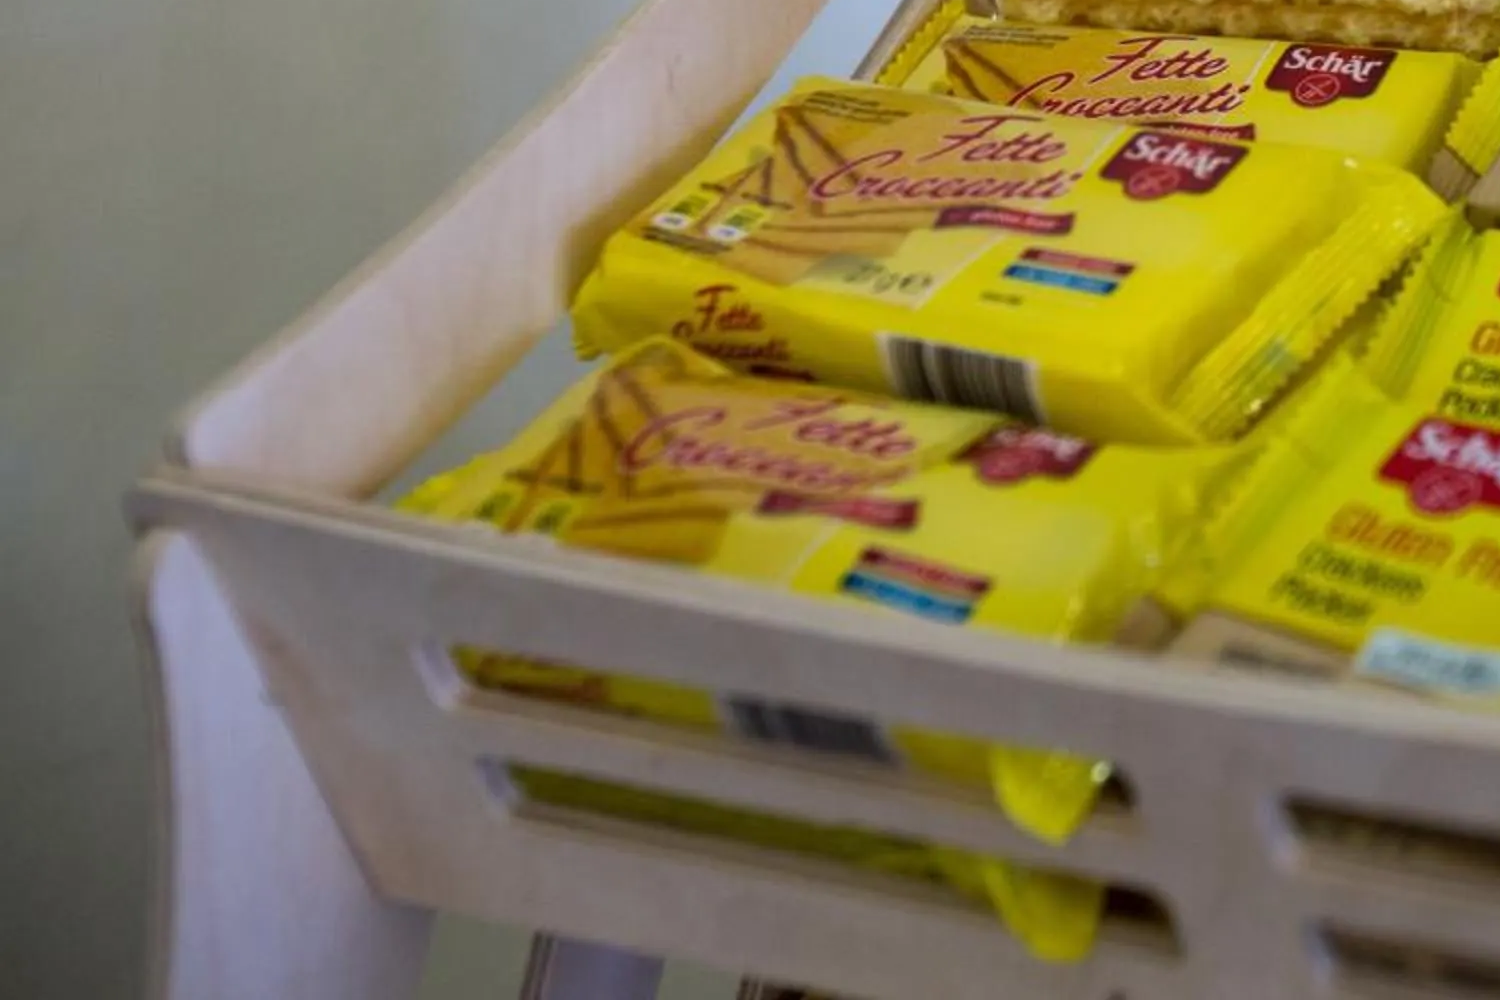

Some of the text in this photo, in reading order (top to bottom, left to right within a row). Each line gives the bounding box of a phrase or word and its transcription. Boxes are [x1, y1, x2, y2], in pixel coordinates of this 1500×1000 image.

[1087, 36, 1231, 84] Fette
[1283, 47, 1384, 81] Schär
[1009, 72, 1251, 120] Croccanti
[923, 114, 1068, 164] Fette
[1123, 136, 1231, 181] Schär
[810, 149, 1084, 199] Croccanti
